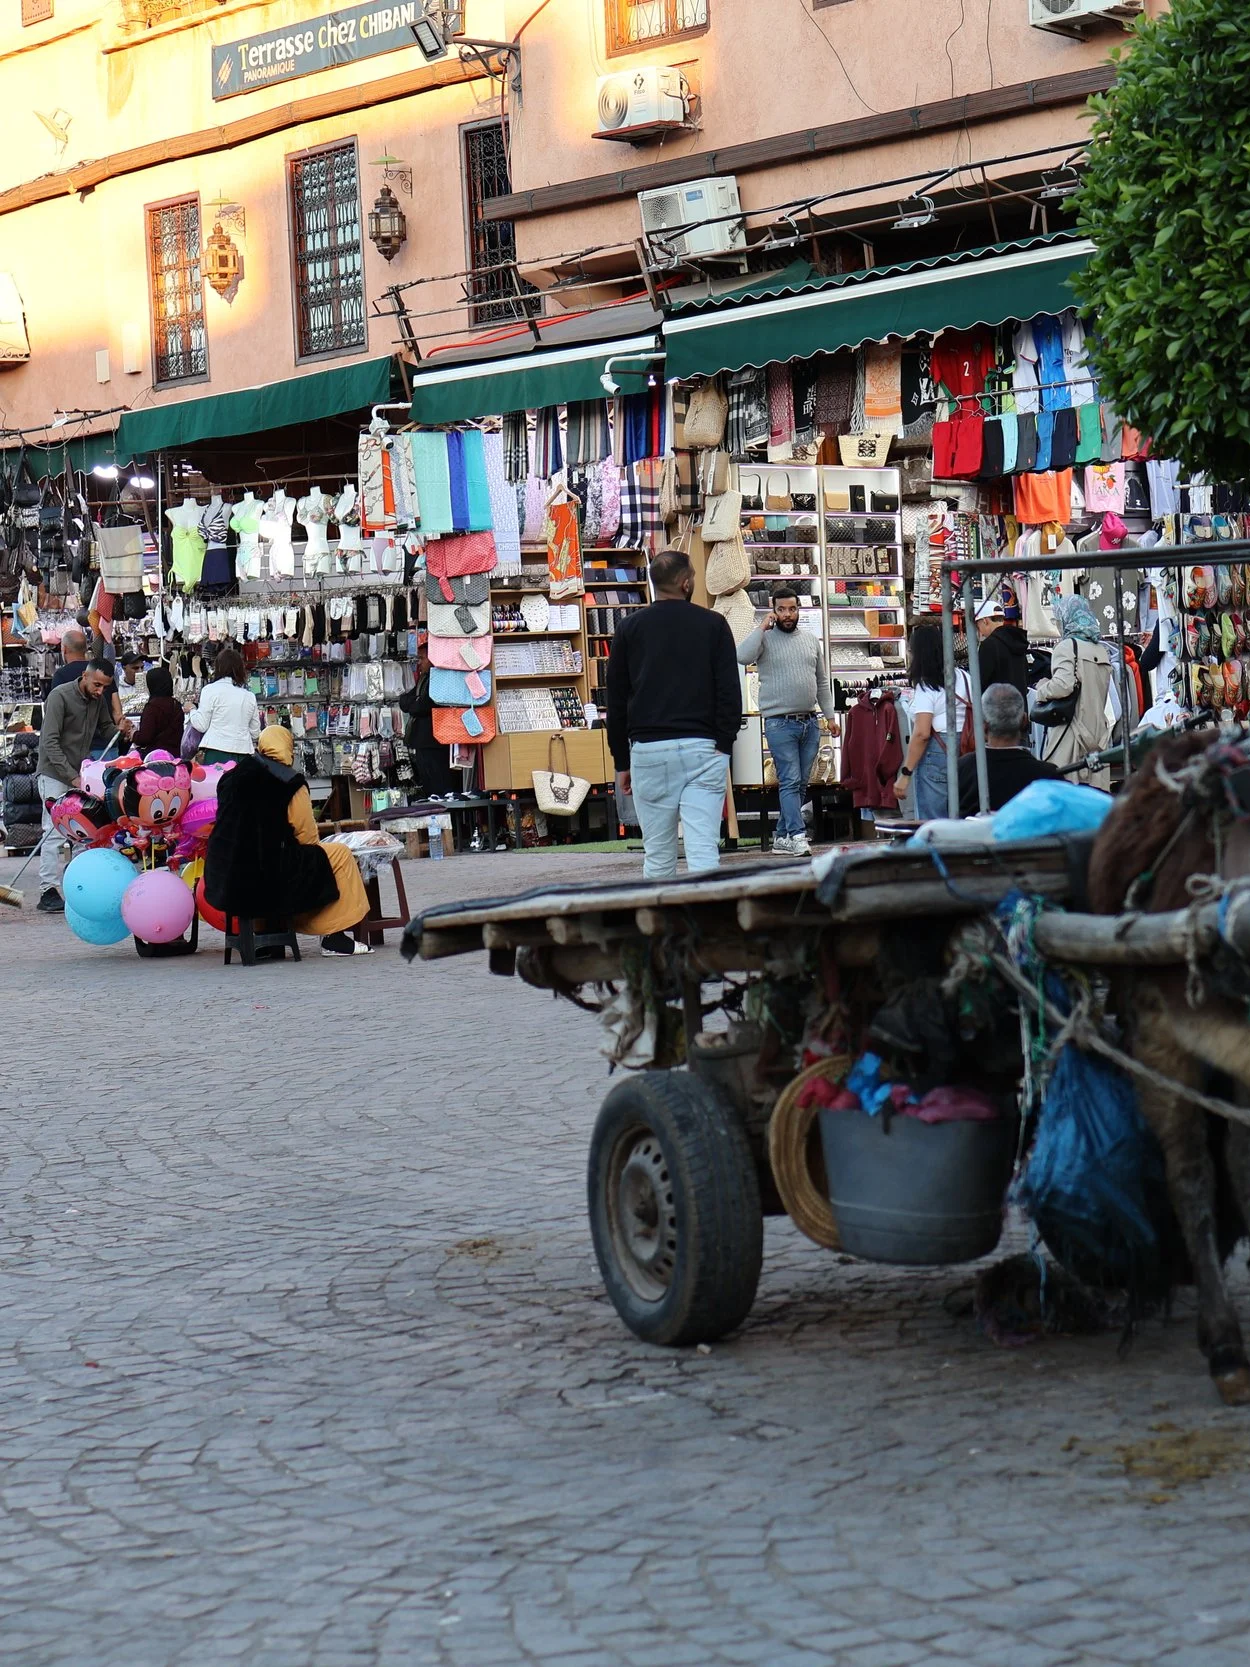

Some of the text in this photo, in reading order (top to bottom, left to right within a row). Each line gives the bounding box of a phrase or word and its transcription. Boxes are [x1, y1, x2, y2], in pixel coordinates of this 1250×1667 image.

[238, 30, 314, 71] Terrasse
[359, 2, 415, 38] CHIBANI
[243, 60, 295, 84] PANORAMIQUE
[963, 361, 970, 377] 2
